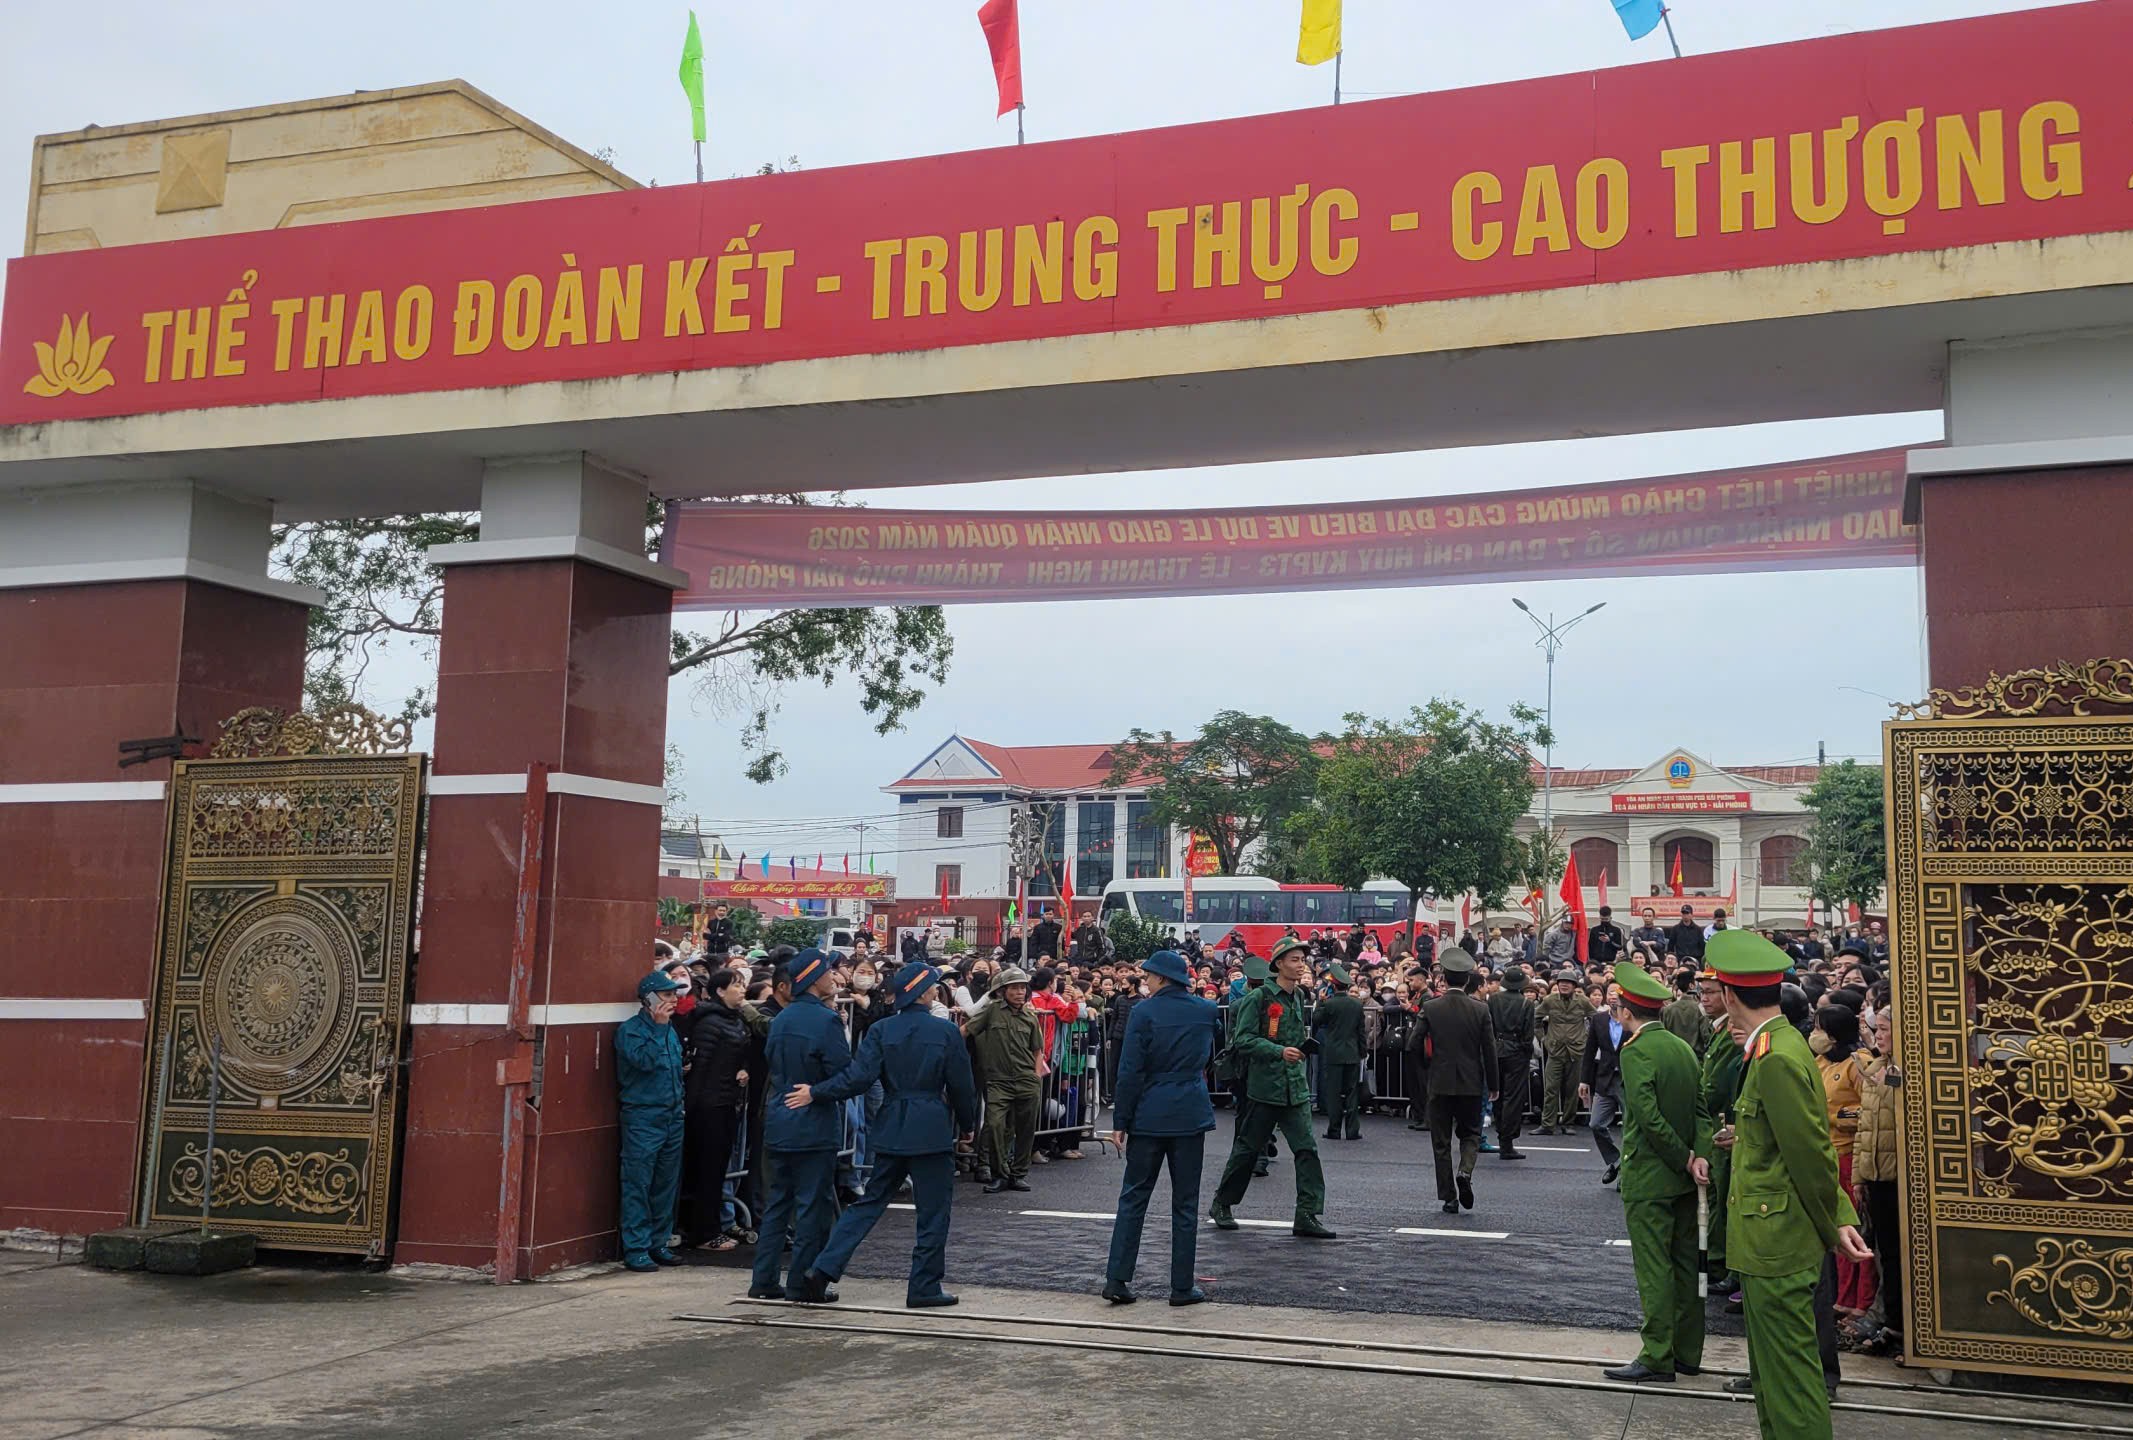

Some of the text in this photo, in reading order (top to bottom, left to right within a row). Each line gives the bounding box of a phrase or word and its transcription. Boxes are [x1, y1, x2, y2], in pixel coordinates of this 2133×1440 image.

[142, 100, 2083, 384] THỂ THAO ĐOÀN KẾT - TRUNG THỰC - CAO THƯỢNG
